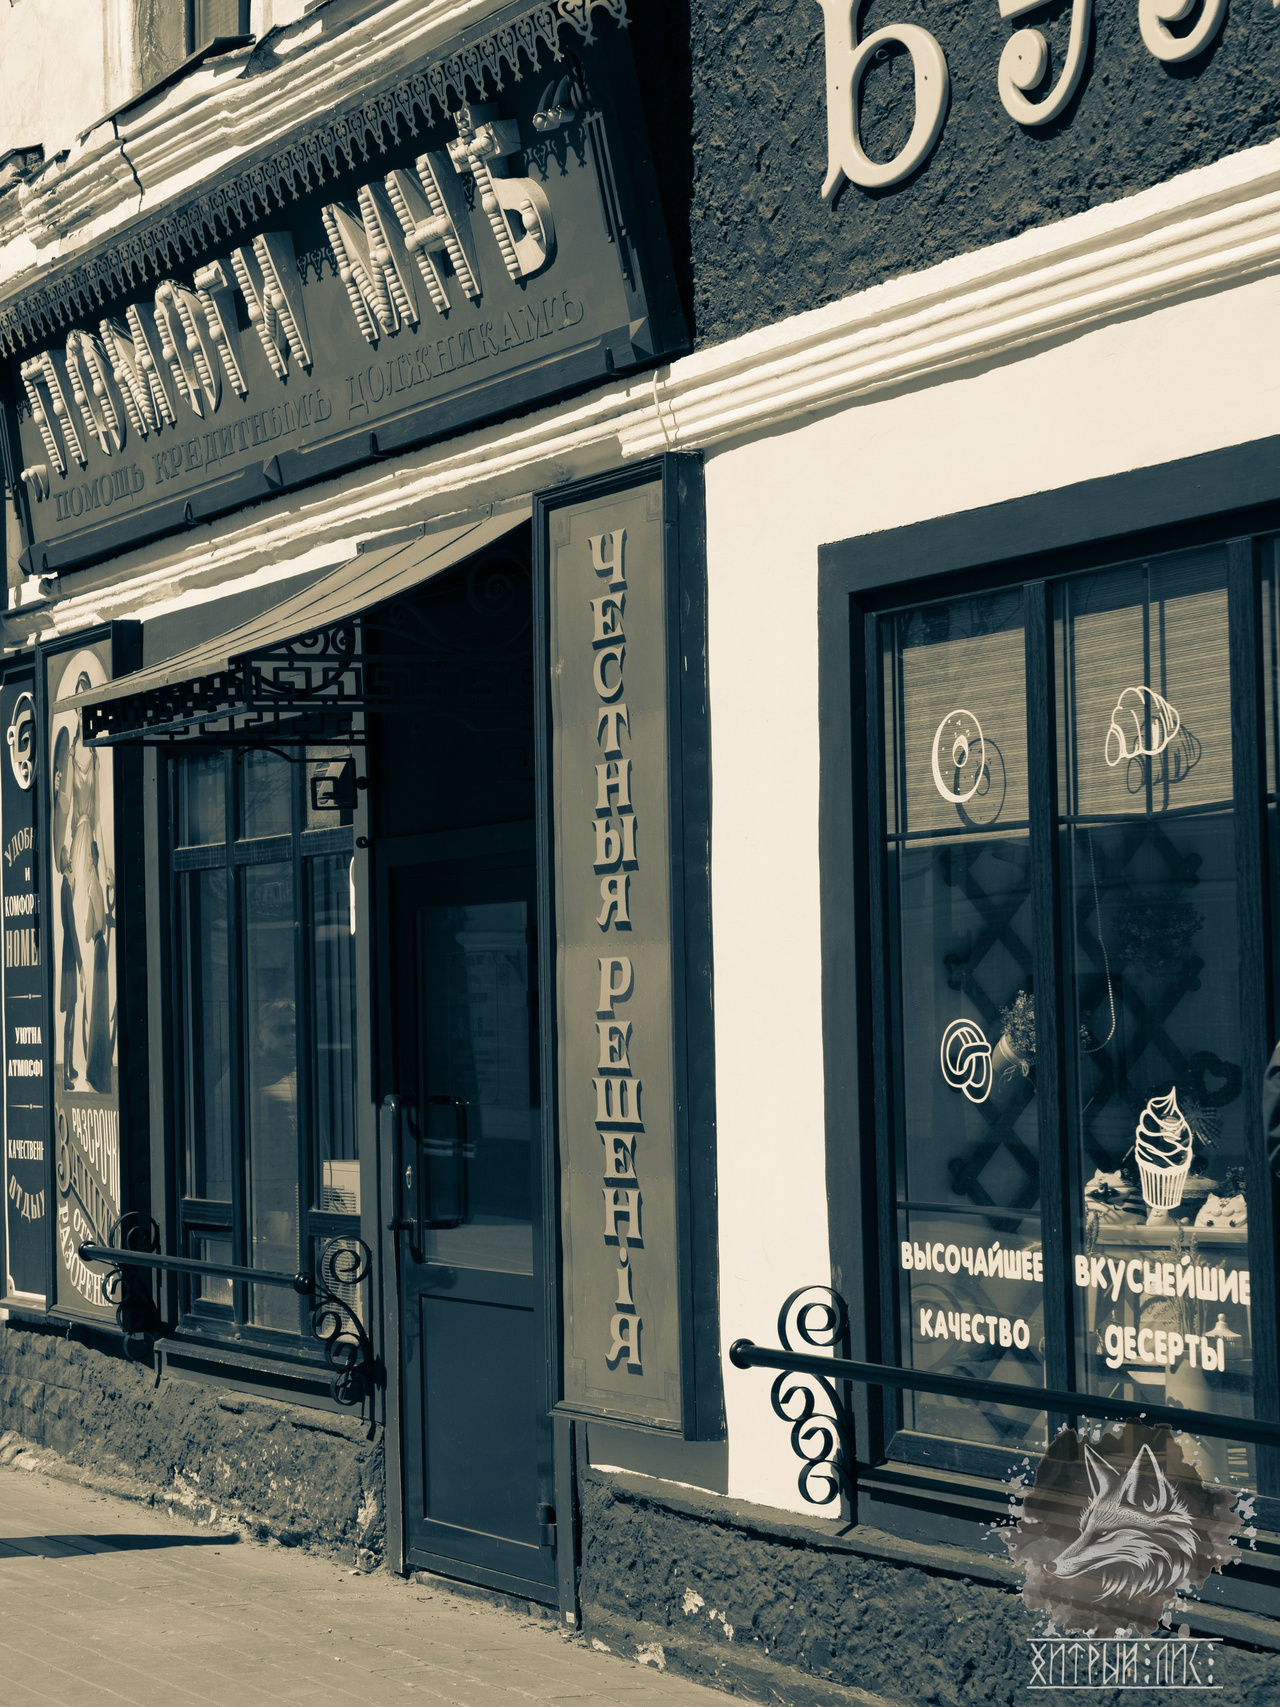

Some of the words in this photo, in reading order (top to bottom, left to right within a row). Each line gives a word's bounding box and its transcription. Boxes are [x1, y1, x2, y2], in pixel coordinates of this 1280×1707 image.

[53, 463, 145, 521] ПОМОЩЬ
[345, 288, 585, 421] ДОЛЖНИКАМЪ
[587, 528, 639, 931] ЧЕСТНЫЯ
[6, 928, 41, 968] НОМЕ
[900, 1241, 1044, 1283] ВЫСОЧАЙШЕЕ
[1074, 1254, 1251, 1306] ВКУСНЕЙШИЕ
[919, 1308, 1030, 1350] КАЧЕСТВО
